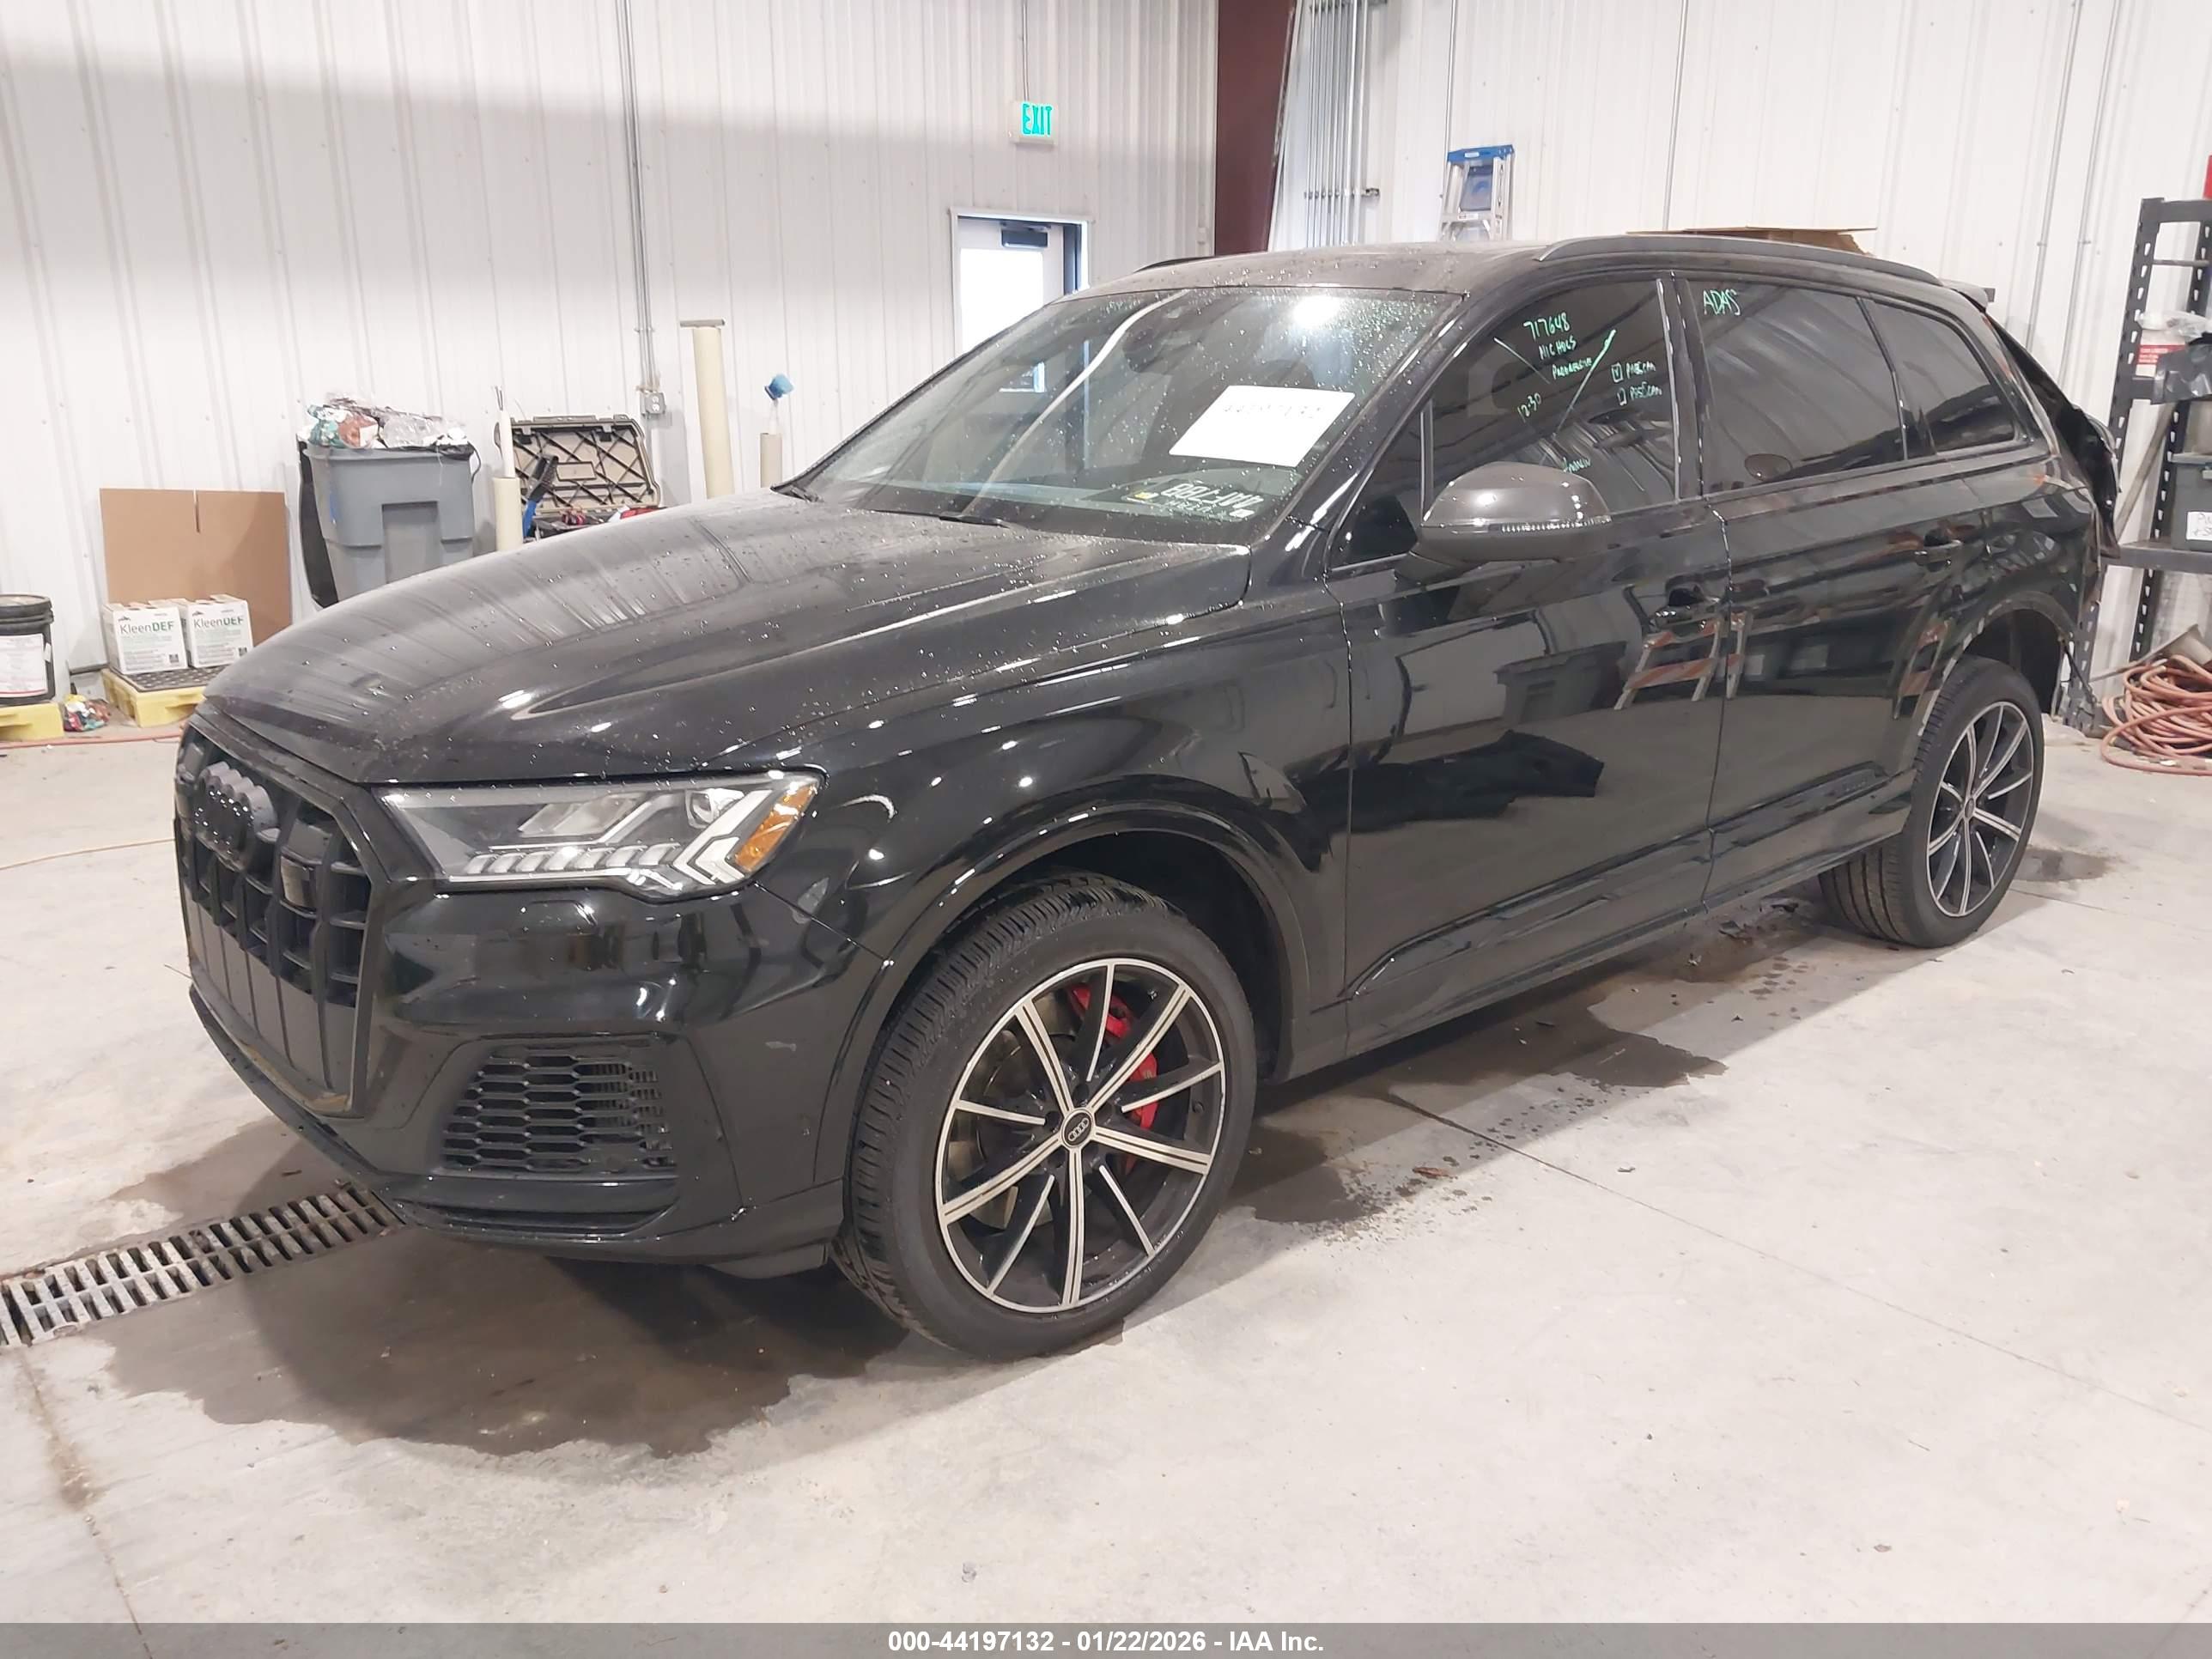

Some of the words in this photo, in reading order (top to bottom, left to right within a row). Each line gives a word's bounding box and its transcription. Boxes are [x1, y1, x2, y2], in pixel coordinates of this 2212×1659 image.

[1023, 103, 1053, 136] EXIT
[1703, 289, 1741, 316] ADAS
[1523, 312, 1571, 341] 717648
[120, 621, 174, 635] KleenDEF
